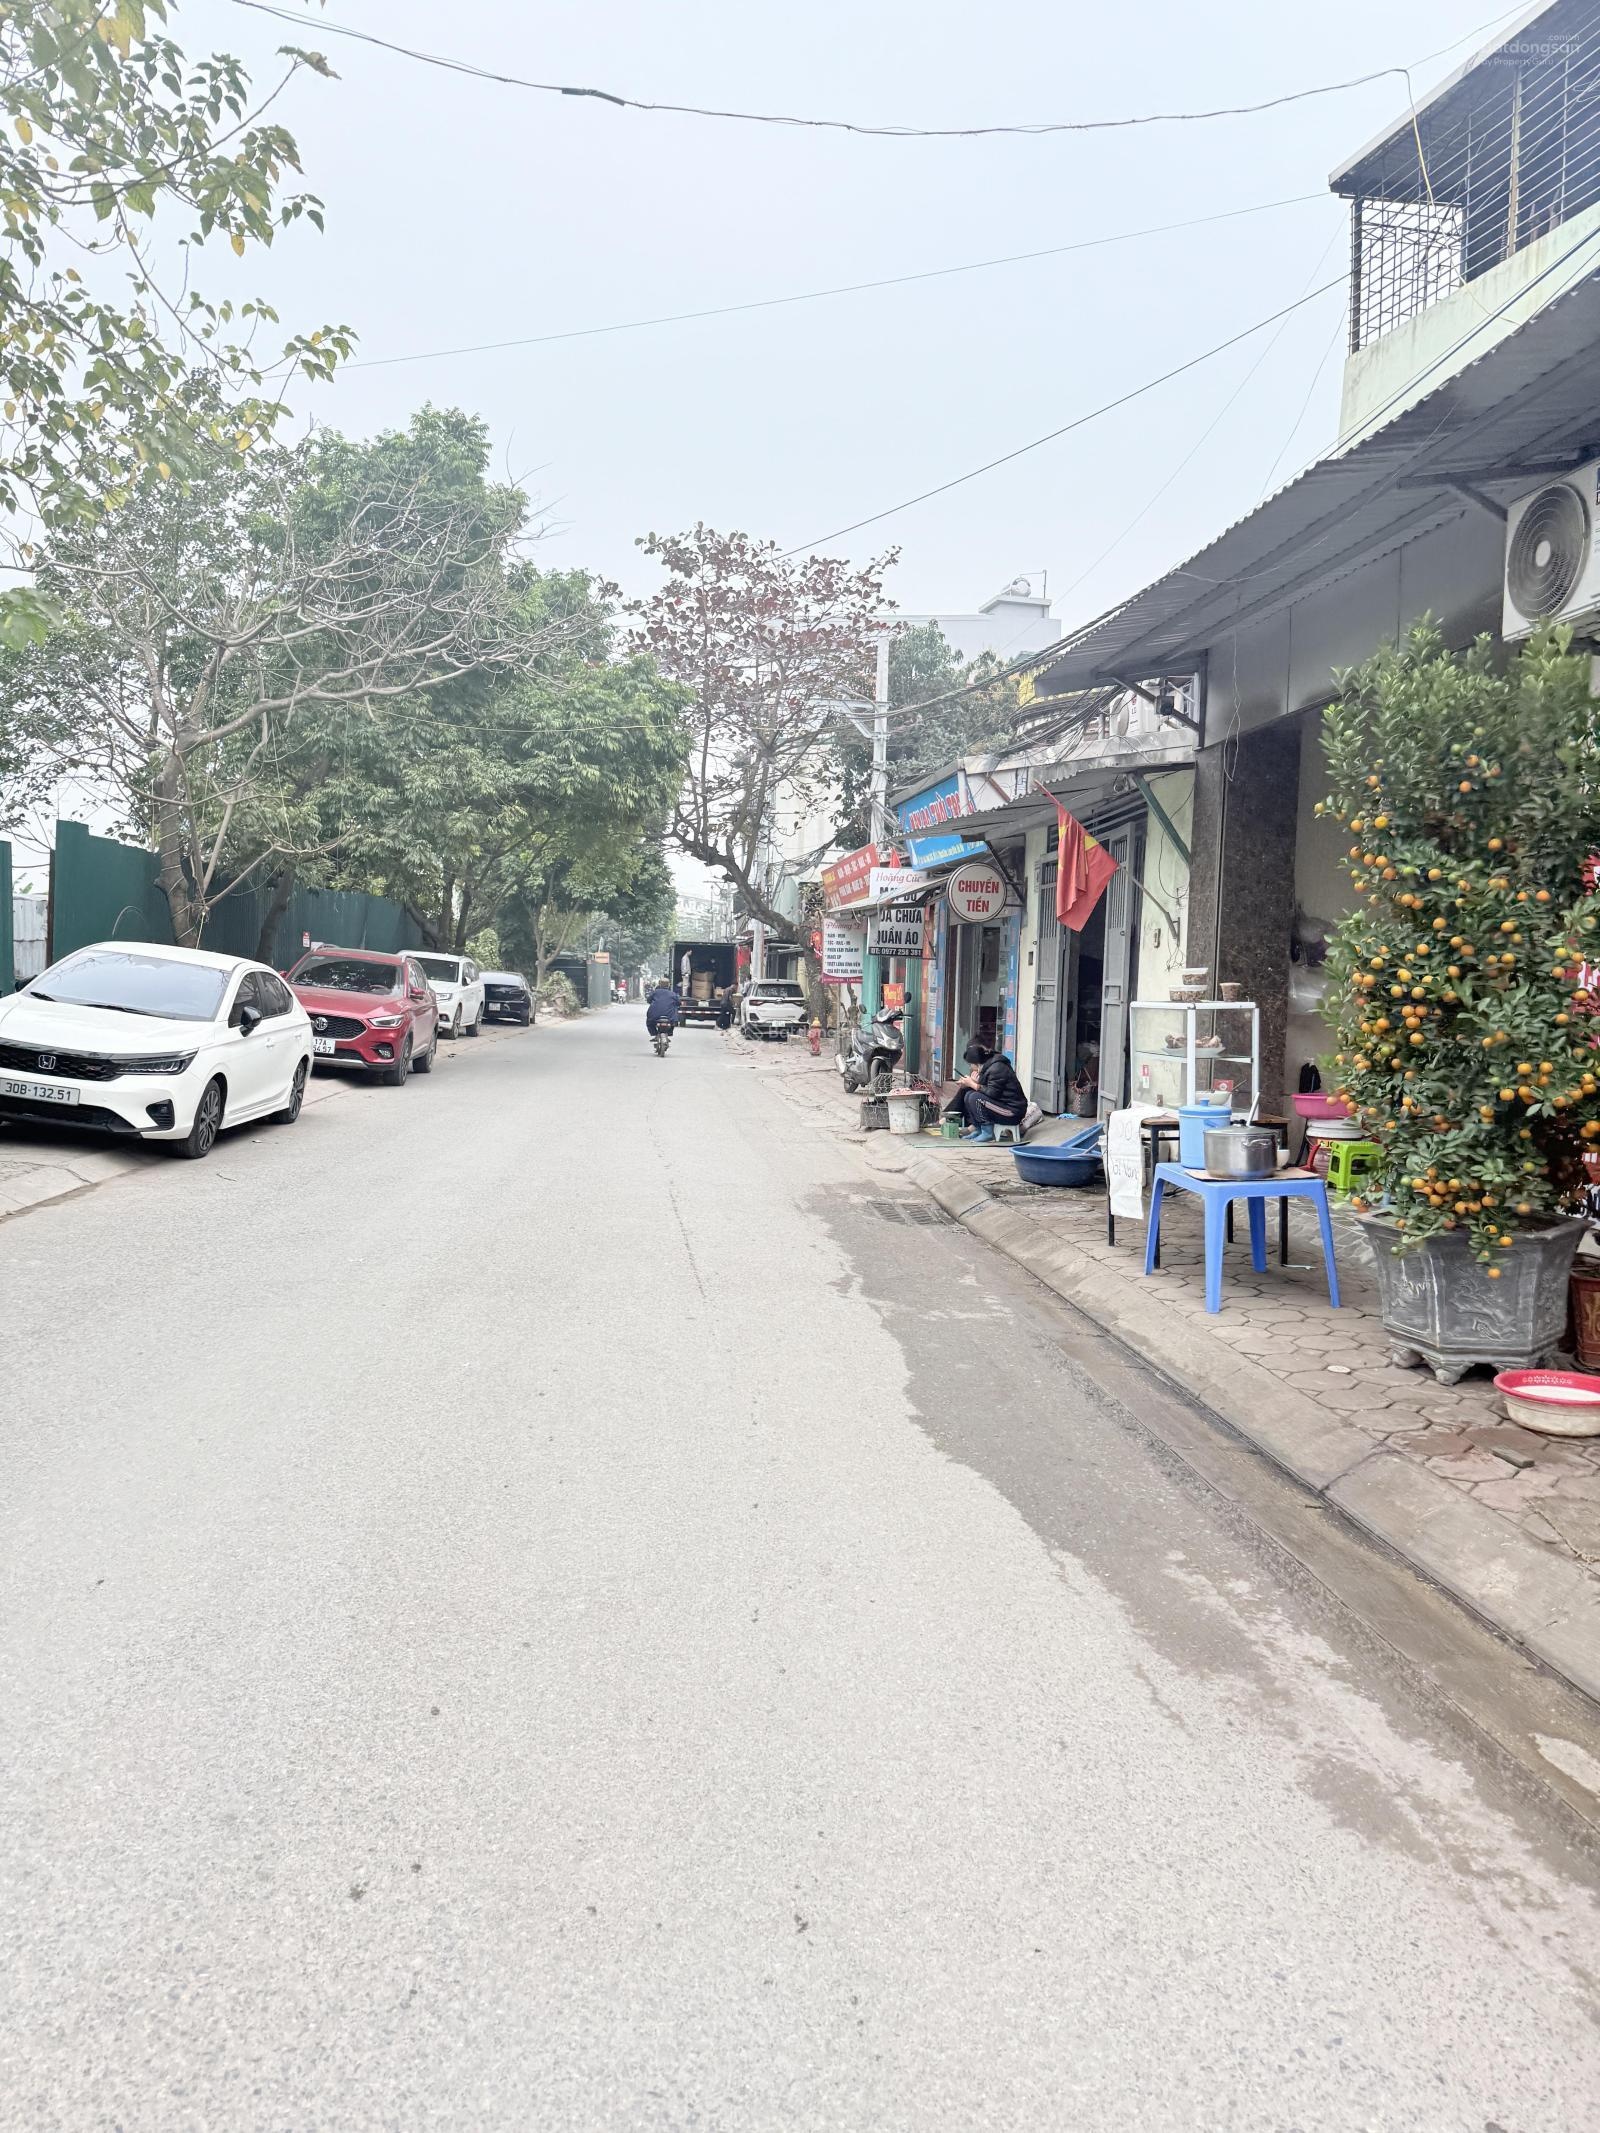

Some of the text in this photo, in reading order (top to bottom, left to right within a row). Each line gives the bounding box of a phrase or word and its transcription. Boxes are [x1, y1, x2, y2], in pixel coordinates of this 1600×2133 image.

[958, 877, 1000, 894] CHUYỂN
[904, 928, 919, 945] ÁO
[4, 1082, 72, 1102] 30B-132.51
